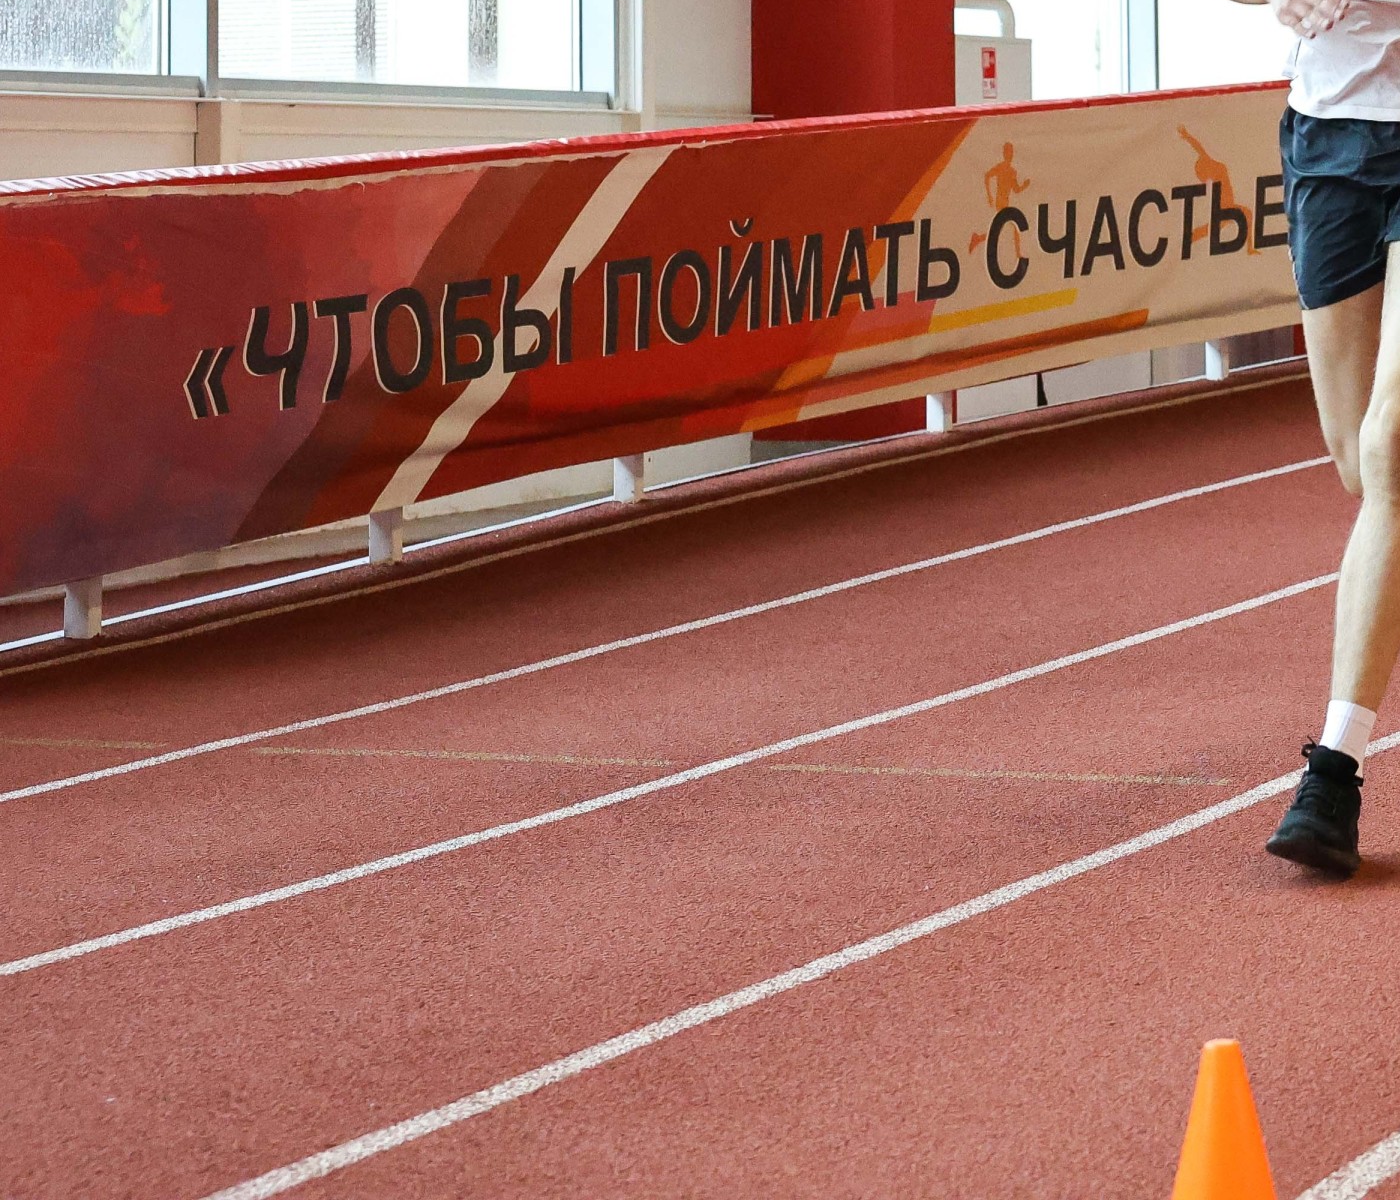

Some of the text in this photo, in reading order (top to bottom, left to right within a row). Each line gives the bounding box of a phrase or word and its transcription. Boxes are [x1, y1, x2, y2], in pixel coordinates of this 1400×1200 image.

[182, 266, 577, 421] «ЧТОБЫ
[601, 217, 961, 357] ПОЙМАТЬ
[985, 173, 1287, 290] СЧАСТЬЕ
